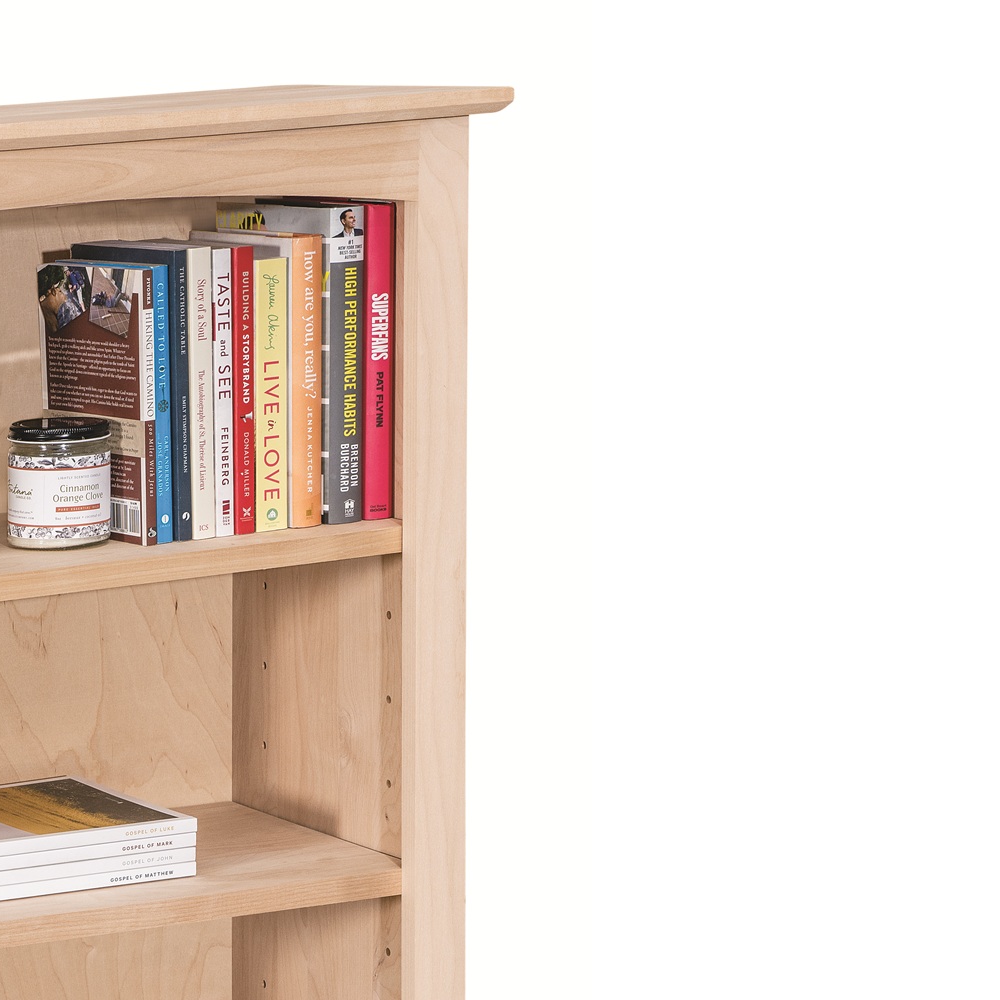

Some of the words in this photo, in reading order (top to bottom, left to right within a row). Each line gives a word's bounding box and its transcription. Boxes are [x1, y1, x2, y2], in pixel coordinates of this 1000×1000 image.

[216, 209, 263, 230] CLARITY
[304, 250, 316, 282] how
[344, 267, 357, 296] HIGH
[195, 279, 206, 300] Story
[218, 273, 230, 331] TASTE
[305, 288, 314, 311] are
[198, 304, 206, 313] of
[198, 322, 207, 341] Soul
[302, 315, 314, 346] you,
[371, 292, 388, 361] SUPERFANS
[158, 335, 165, 352] TO
[220, 340, 229, 357] and
[344, 300, 357, 390] PERFORMANCE
[218, 365, 231, 399] SEE
[264, 361, 280, 415] LIVE
[302, 350, 316, 399] really?
[197, 382, 205, 422] Autobiography
[344, 394, 356, 437] HABITS
[268, 420, 276, 431] in
[221, 427, 230, 486] FEINBERG
[264, 435, 280, 501] LOVE
[340, 444, 349, 492] BURCHARD
[53, 494, 84, 503] Orange
[85, 491, 103, 500] Clove
[60, 484, 99, 493] Cinnamon
